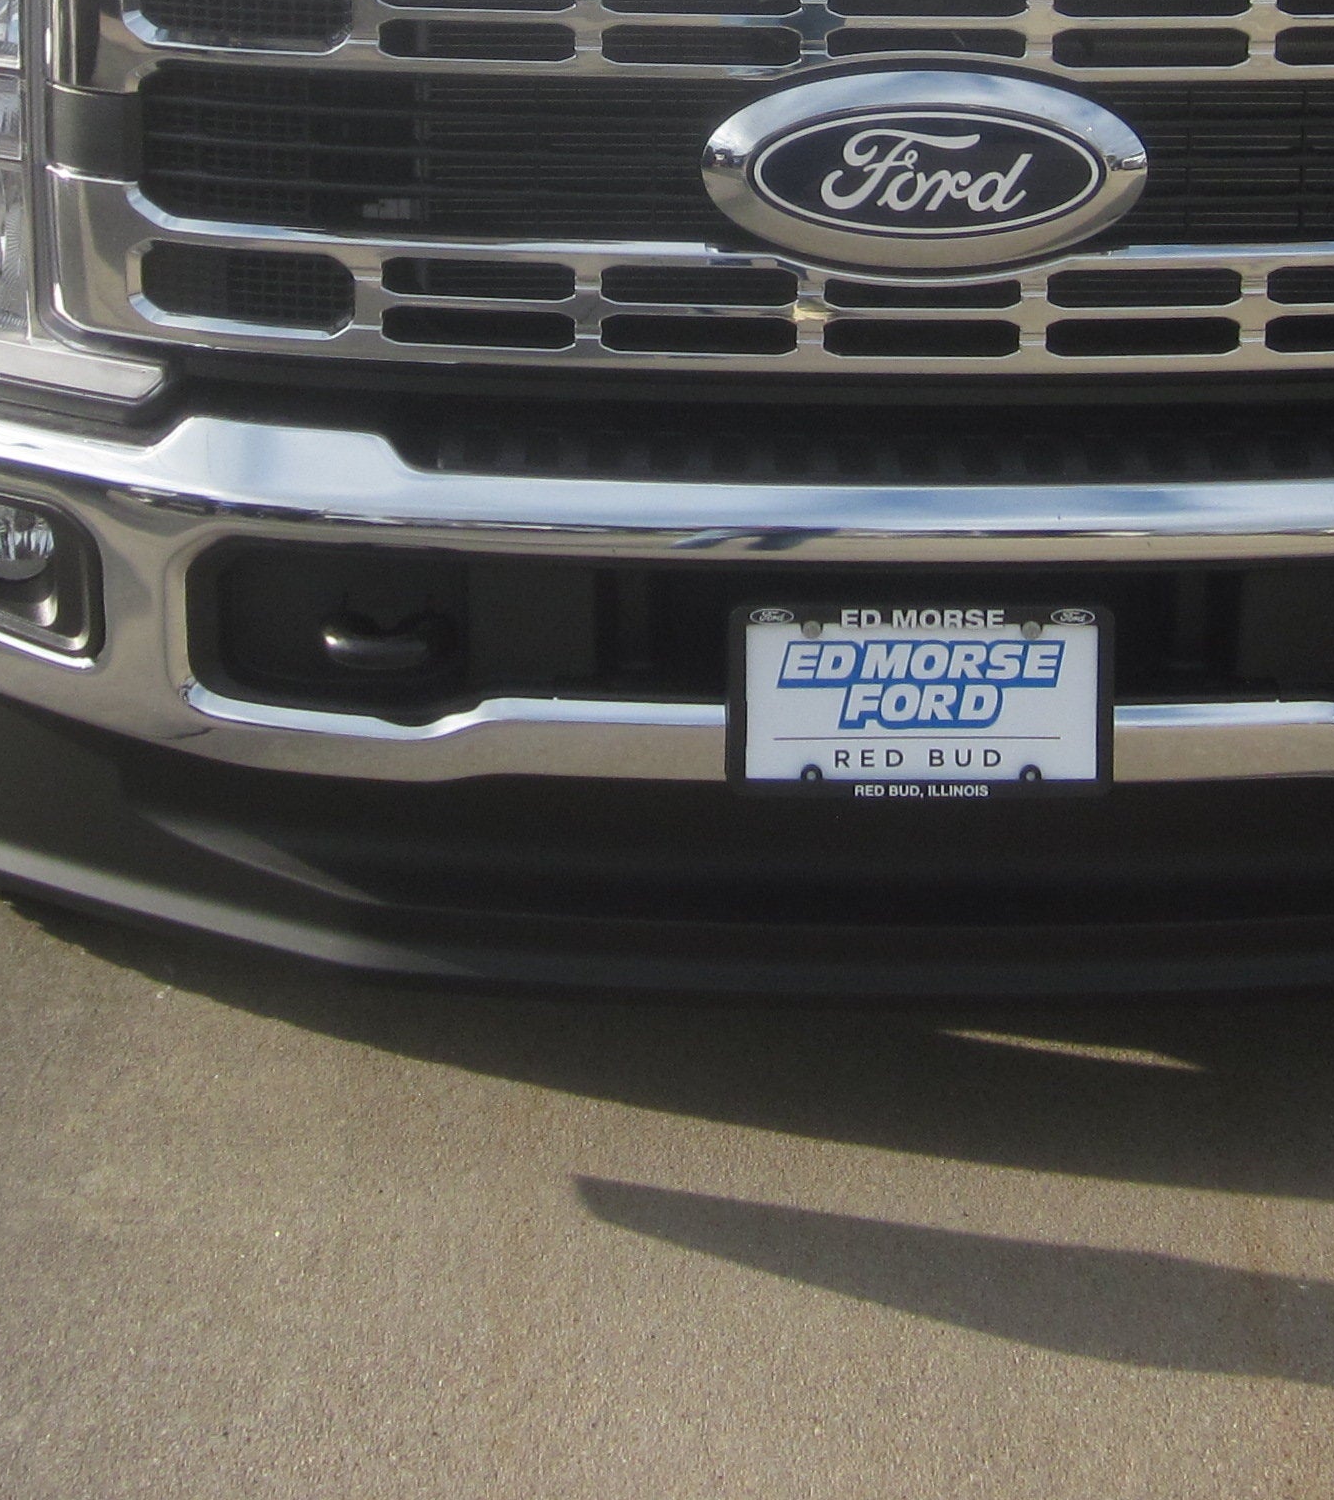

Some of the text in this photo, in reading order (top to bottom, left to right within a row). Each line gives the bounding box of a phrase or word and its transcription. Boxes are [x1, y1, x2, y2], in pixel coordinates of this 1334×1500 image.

[821, 128, 1034, 212] Ford
[759, 610, 784, 622] Ford
[841, 609, 1005, 630] ED MORSE
[1059, 610, 1086, 622] Ford
[781, 643, 1061, 680] ED MORSE
[844, 683, 999, 722] FORD
[835, 749, 1002, 769] RED BUD
[854, 784, 989, 799] RED BUD, ILLINOIS
